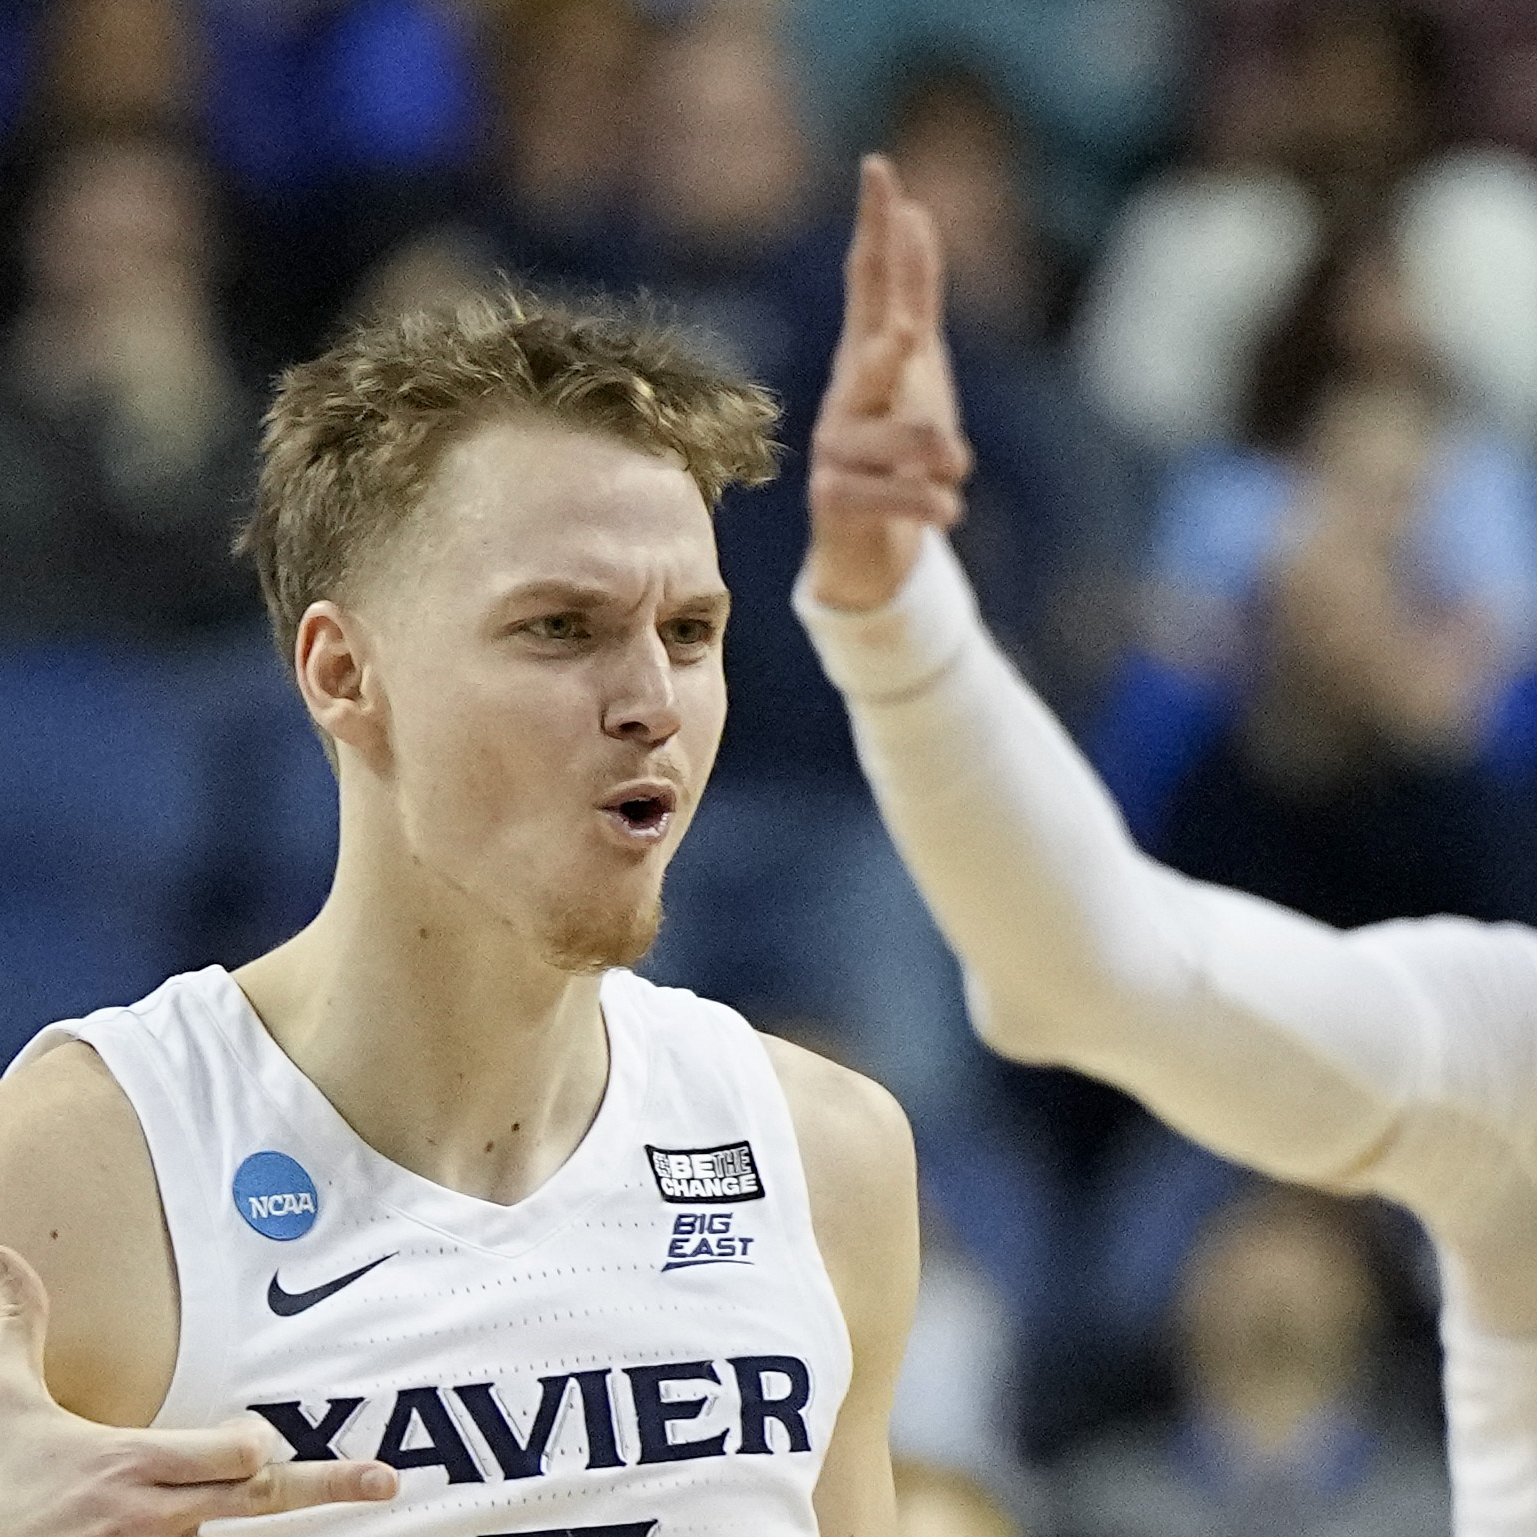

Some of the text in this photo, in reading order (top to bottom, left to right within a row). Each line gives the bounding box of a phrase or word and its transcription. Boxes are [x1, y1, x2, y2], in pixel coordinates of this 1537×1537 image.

[660, 1173, 759, 1198] CHANGE
[248, 1192, 316, 1219] NCAA
[672, 1212, 734, 1235] BIG
[667, 1237, 755, 1258] EAST
[246, 1355, 813, 1486] XAVIER
